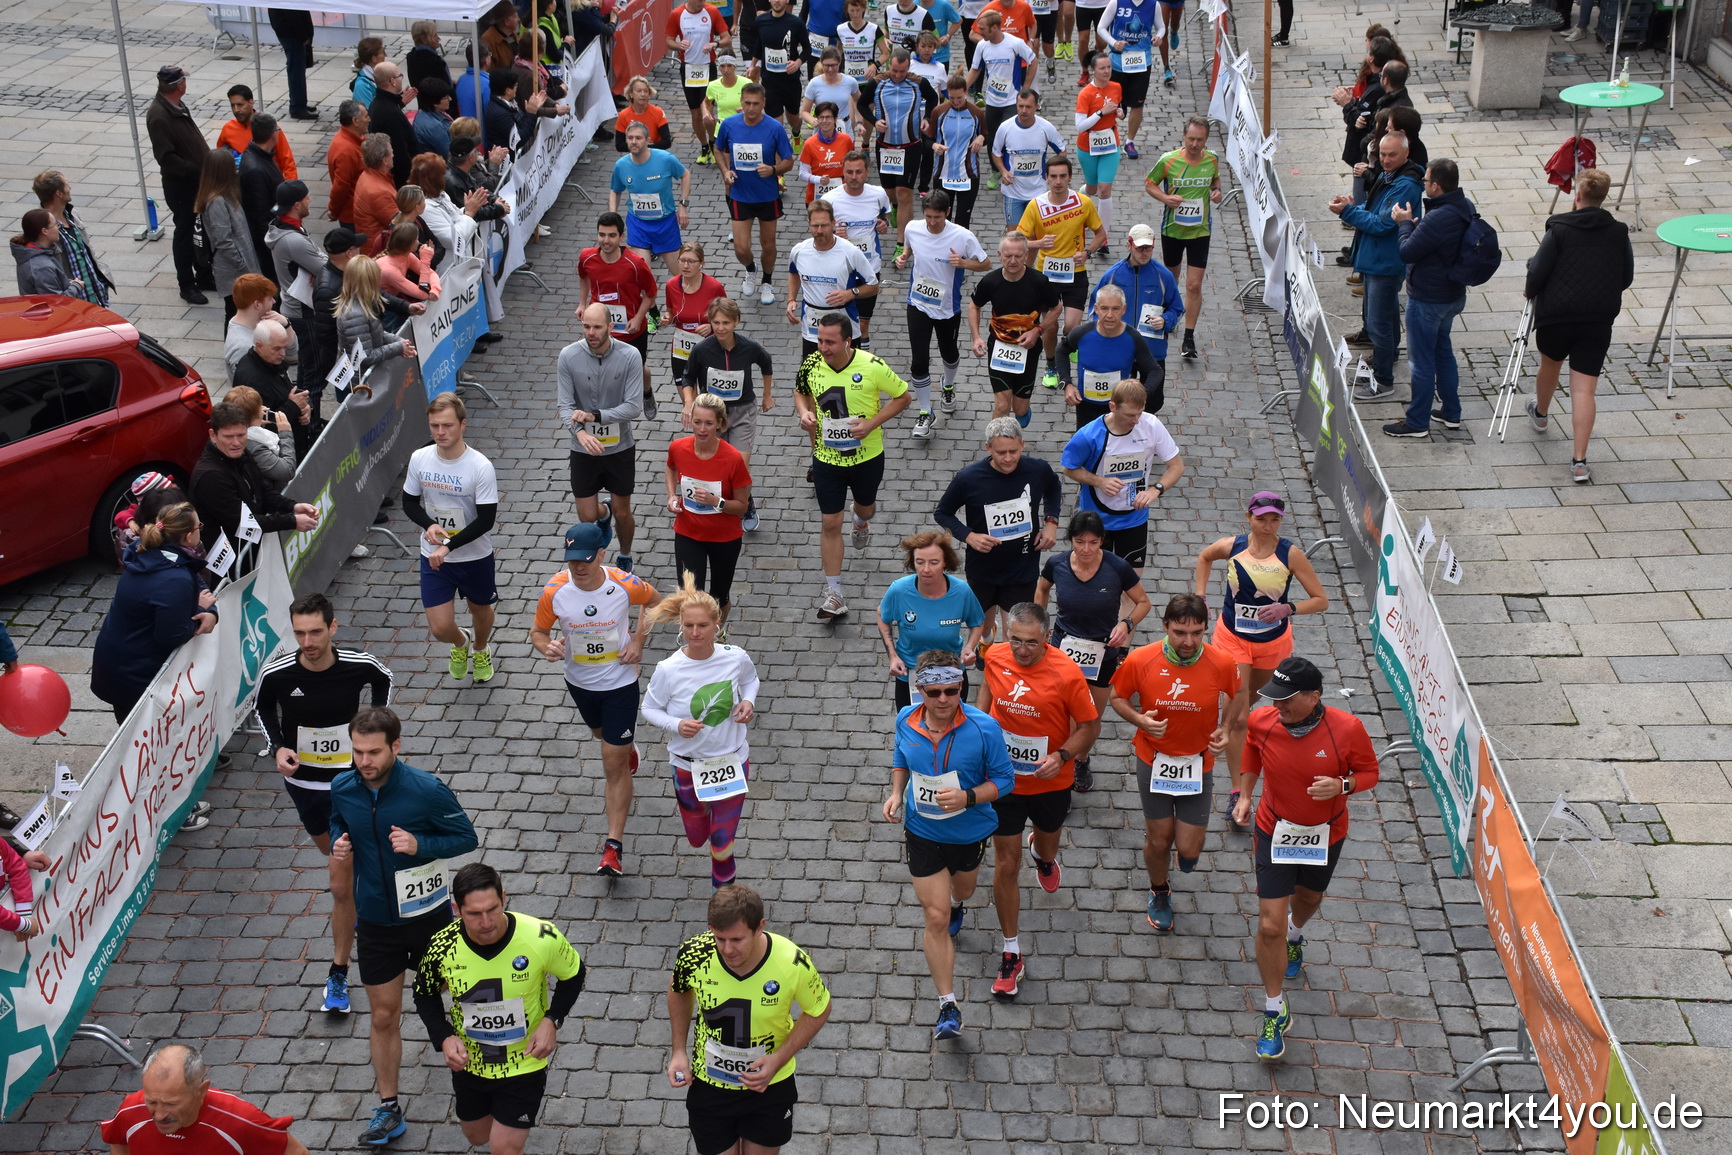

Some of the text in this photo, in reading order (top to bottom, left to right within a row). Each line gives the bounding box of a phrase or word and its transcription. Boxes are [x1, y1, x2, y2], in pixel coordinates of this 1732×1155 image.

[1117, 8, 1132, 17] 33
[810, 40, 824, 50] 2585
[768, 56, 783, 64] 2461
[1125, 57, 1142, 65] 2085
[691, 70, 704, 78] 295
[991, 80, 1008, 92] 2427
[1093, 137, 1112, 146] 2031
[738, 152, 758, 160] 2063
[884, 156, 902, 164] 2702
[1018, 162, 1037, 170] 2307
[1173, 177, 1212, 188] BOCK
[636, 202, 657, 210] 2715
[1178, 206, 1200, 216] 2774
[1042, 209, 1084, 228] MAX BÖGL
[1048, 260, 1070, 272] 2616
[916, 283, 940, 298] 2306
[998, 349, 1022, 361] 2452
[334, 366, 347, 383] swn
[712, 378, 738, 390] 2239
[1095, 381, 1108, 391] 88
[592, 425, 609, 436] 141
[1110, 460, 1139, 472] 2028
[433, 472, 462, 486] BANK
[993, 510, 1026, 526] 2129
[1003, 527, 1019, 536] Ludwig
[212, 546, 228, 570] swn
[1241, 606, 1258, 618] 27
[568, 619, 616, 629] SportScheck
[587, 643, 604, 654] 86
[1066, 648, 1096, 665] 2325
[996, 698, 1035, 712] funrunners
[1155, 698, 1196, 708] funrunners
[1006, 706, 1040, 718] neumarkt
[310, 739, 340, 753] 130
[700, 765, 736, 786] 2329
[1160, 764, 1193, 779] 2911
[1161, 782, 1193, 791] THOMAS
[24, 812, 48, 840] swn
[1281, 834, 1320, 846] 2730
[1276, 846, 1320, 858] THOMAS
[406, 872, 442, 900] 2136
[36, 814, 140, 1005] EINFACH
[88, 904, 137, 986] Service-Line:
[1518, 926, 1528, 941] für
[1525, 941, 1535, 956] die
[1529, 921, 1552, 968] Neumarkts
[512, 972, 530, 980] Partl
[761, 996, 779, 1005] Partl
[472, 1013, 516, 1030] 2694
